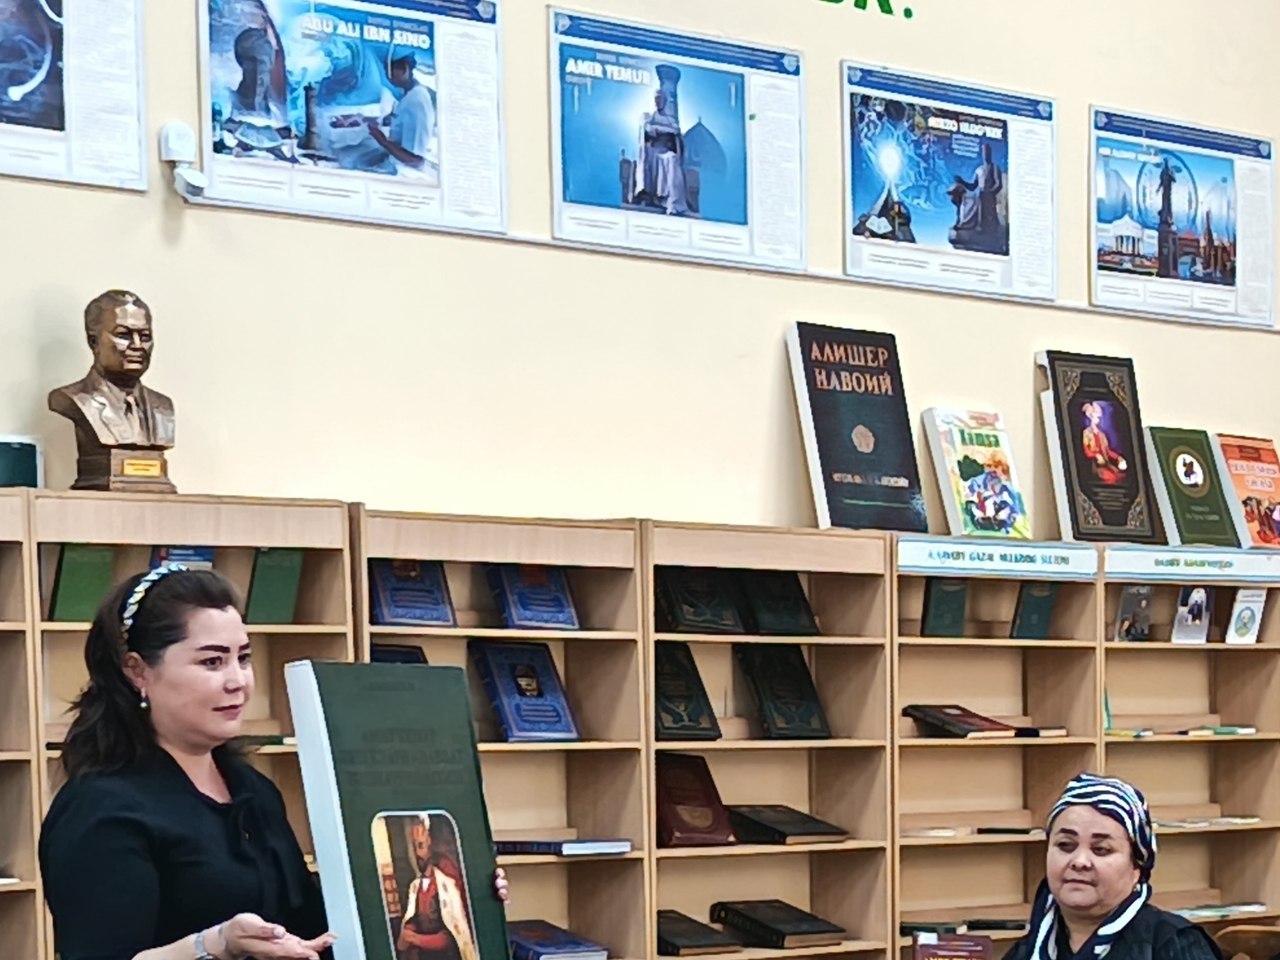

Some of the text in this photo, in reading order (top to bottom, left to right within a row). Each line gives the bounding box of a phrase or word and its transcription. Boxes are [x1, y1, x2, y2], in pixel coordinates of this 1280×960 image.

[363, 24, 391, 43] IBN
[393, 29, 431, 49] SINO
[565, 57, 604, 78] AMIR
[604, 64, 652, 85] TEMUR
[811, 341, 889, 368] АЛИШЕР
[814, 367, 893, 396] НАВОИЙ
